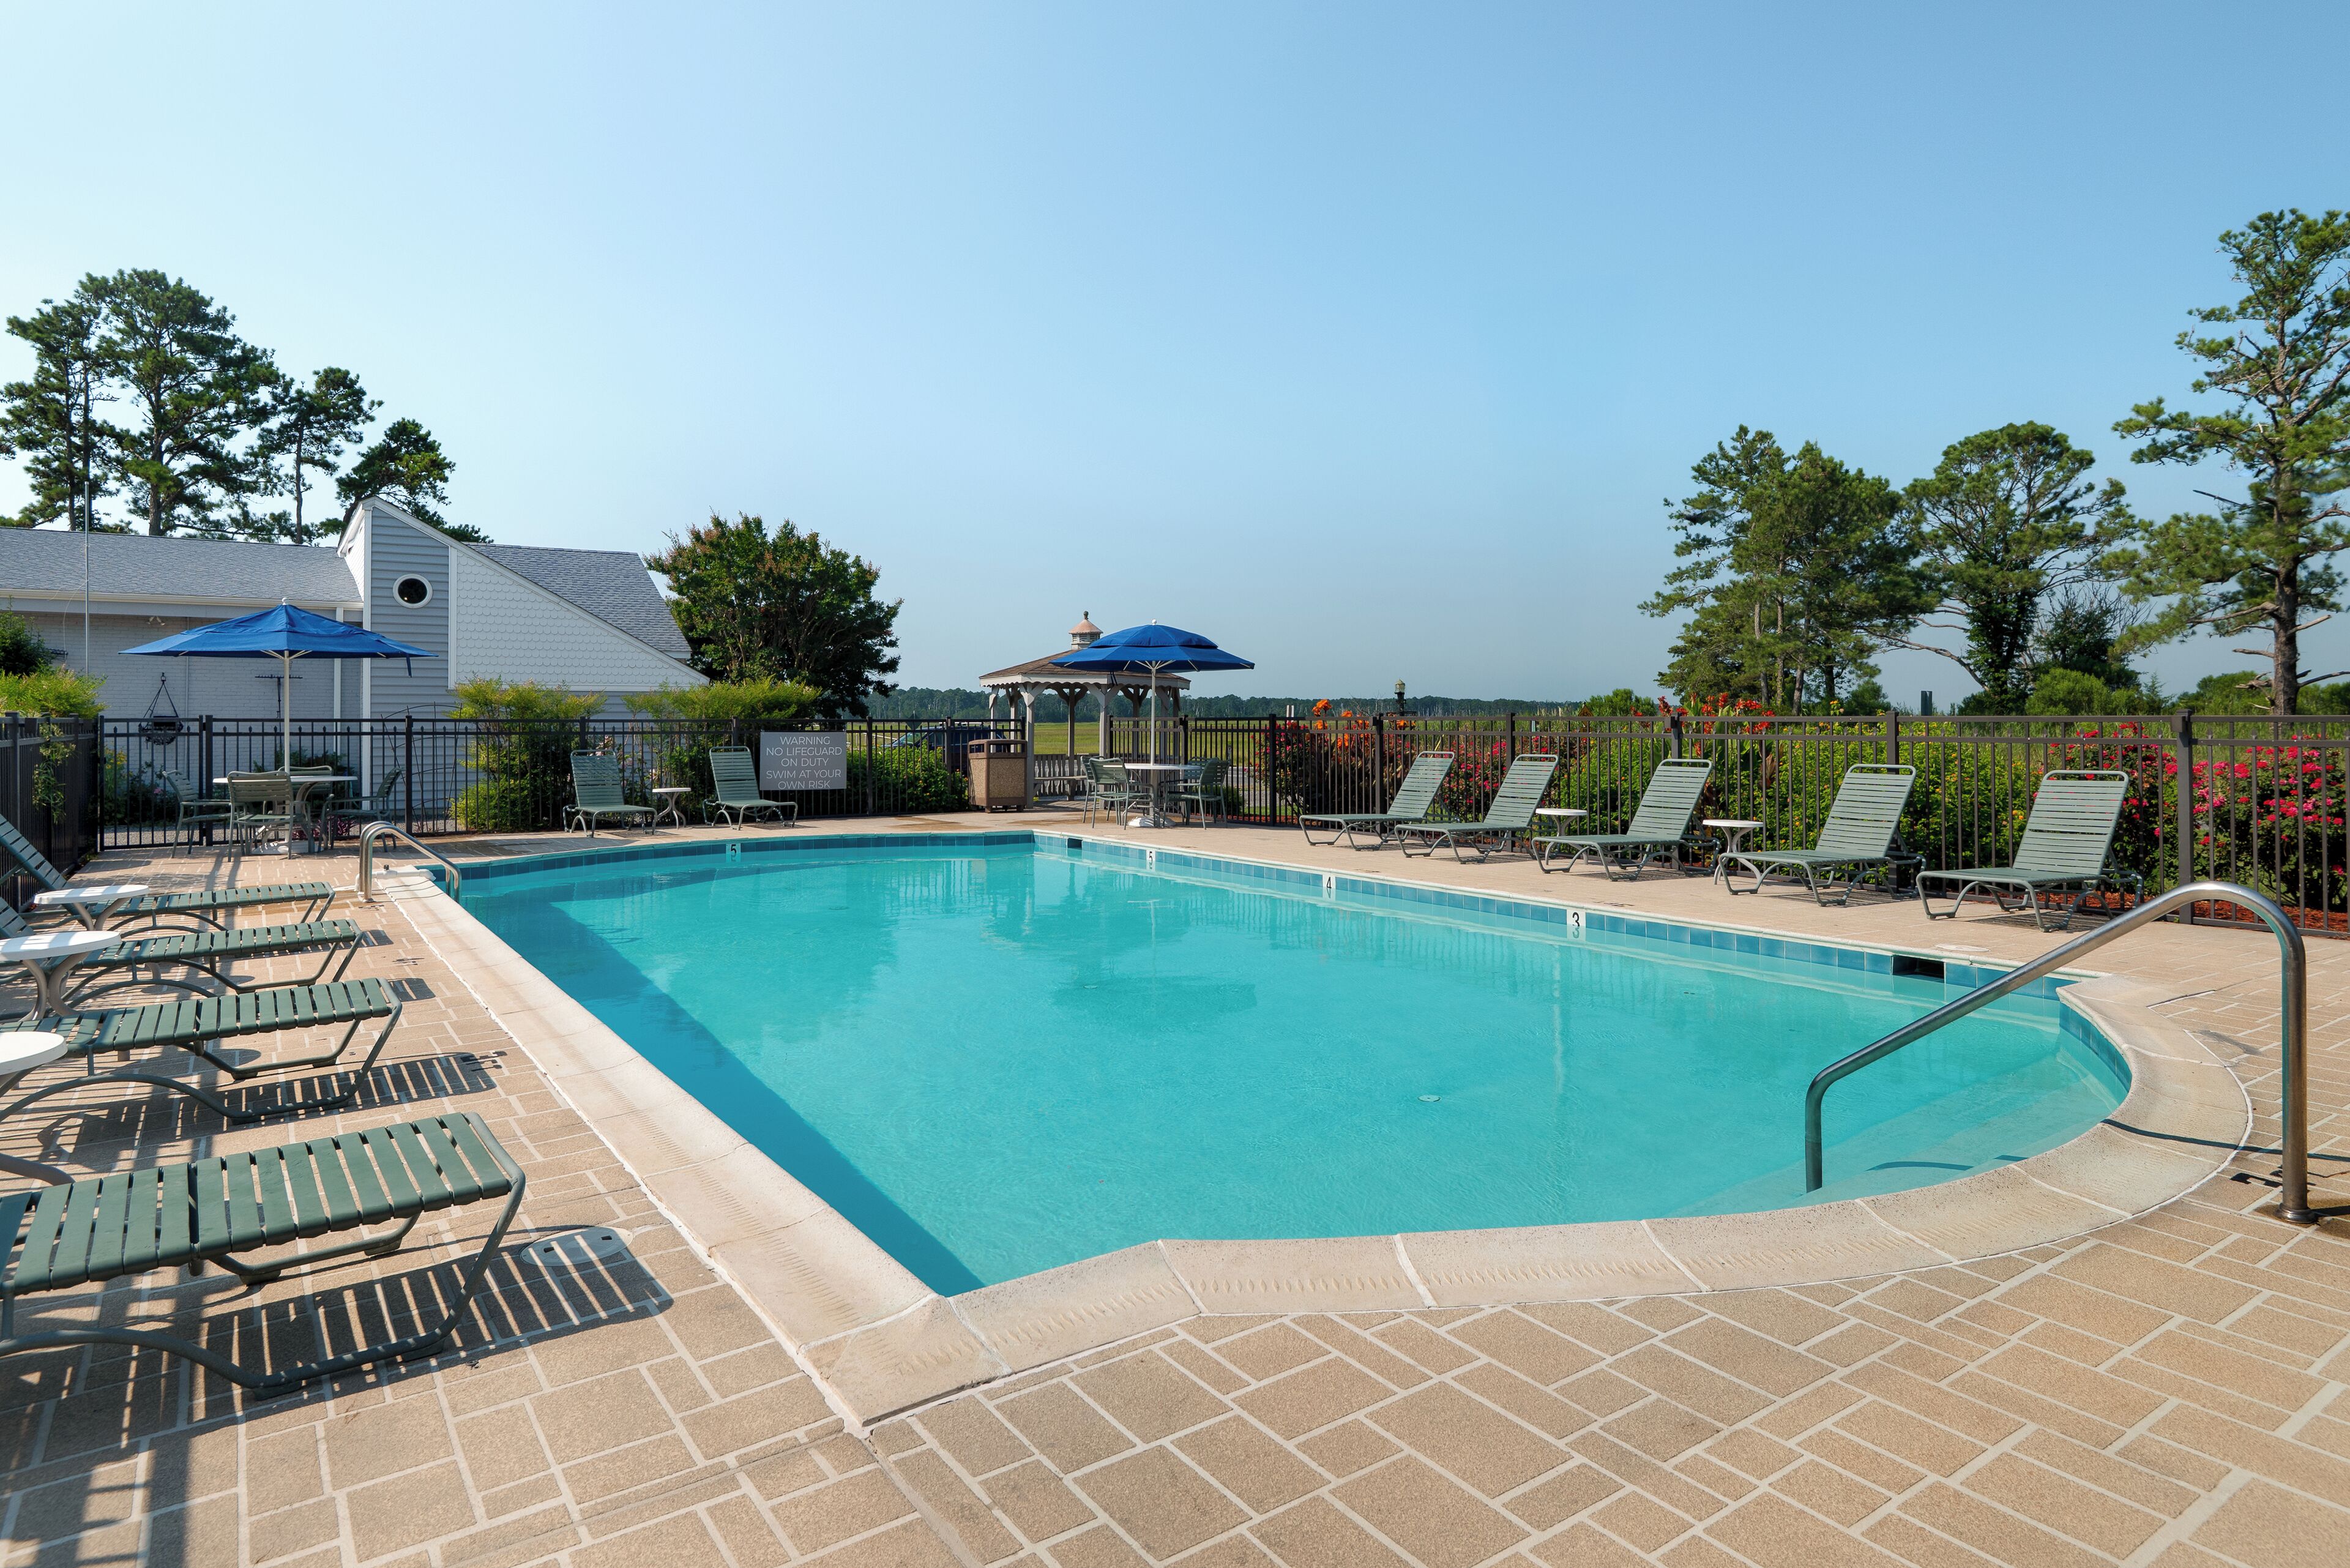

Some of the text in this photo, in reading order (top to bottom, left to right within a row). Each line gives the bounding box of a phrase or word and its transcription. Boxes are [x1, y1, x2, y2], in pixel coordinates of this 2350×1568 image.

[780, 736, 830, 745] WARNING
[766, 747, 842, 756] NO LIFEGUARD
[781, 758, 829, 767] ON DUTY
[766, 769, 841, 779] SWIM AT YOUR
[778, 780, 830, 790] OWN RISK
[730, 844, 737, 854] 5
[1326, 876, 1332, 889] 4
[1572, 912, 1580, 927] 3
